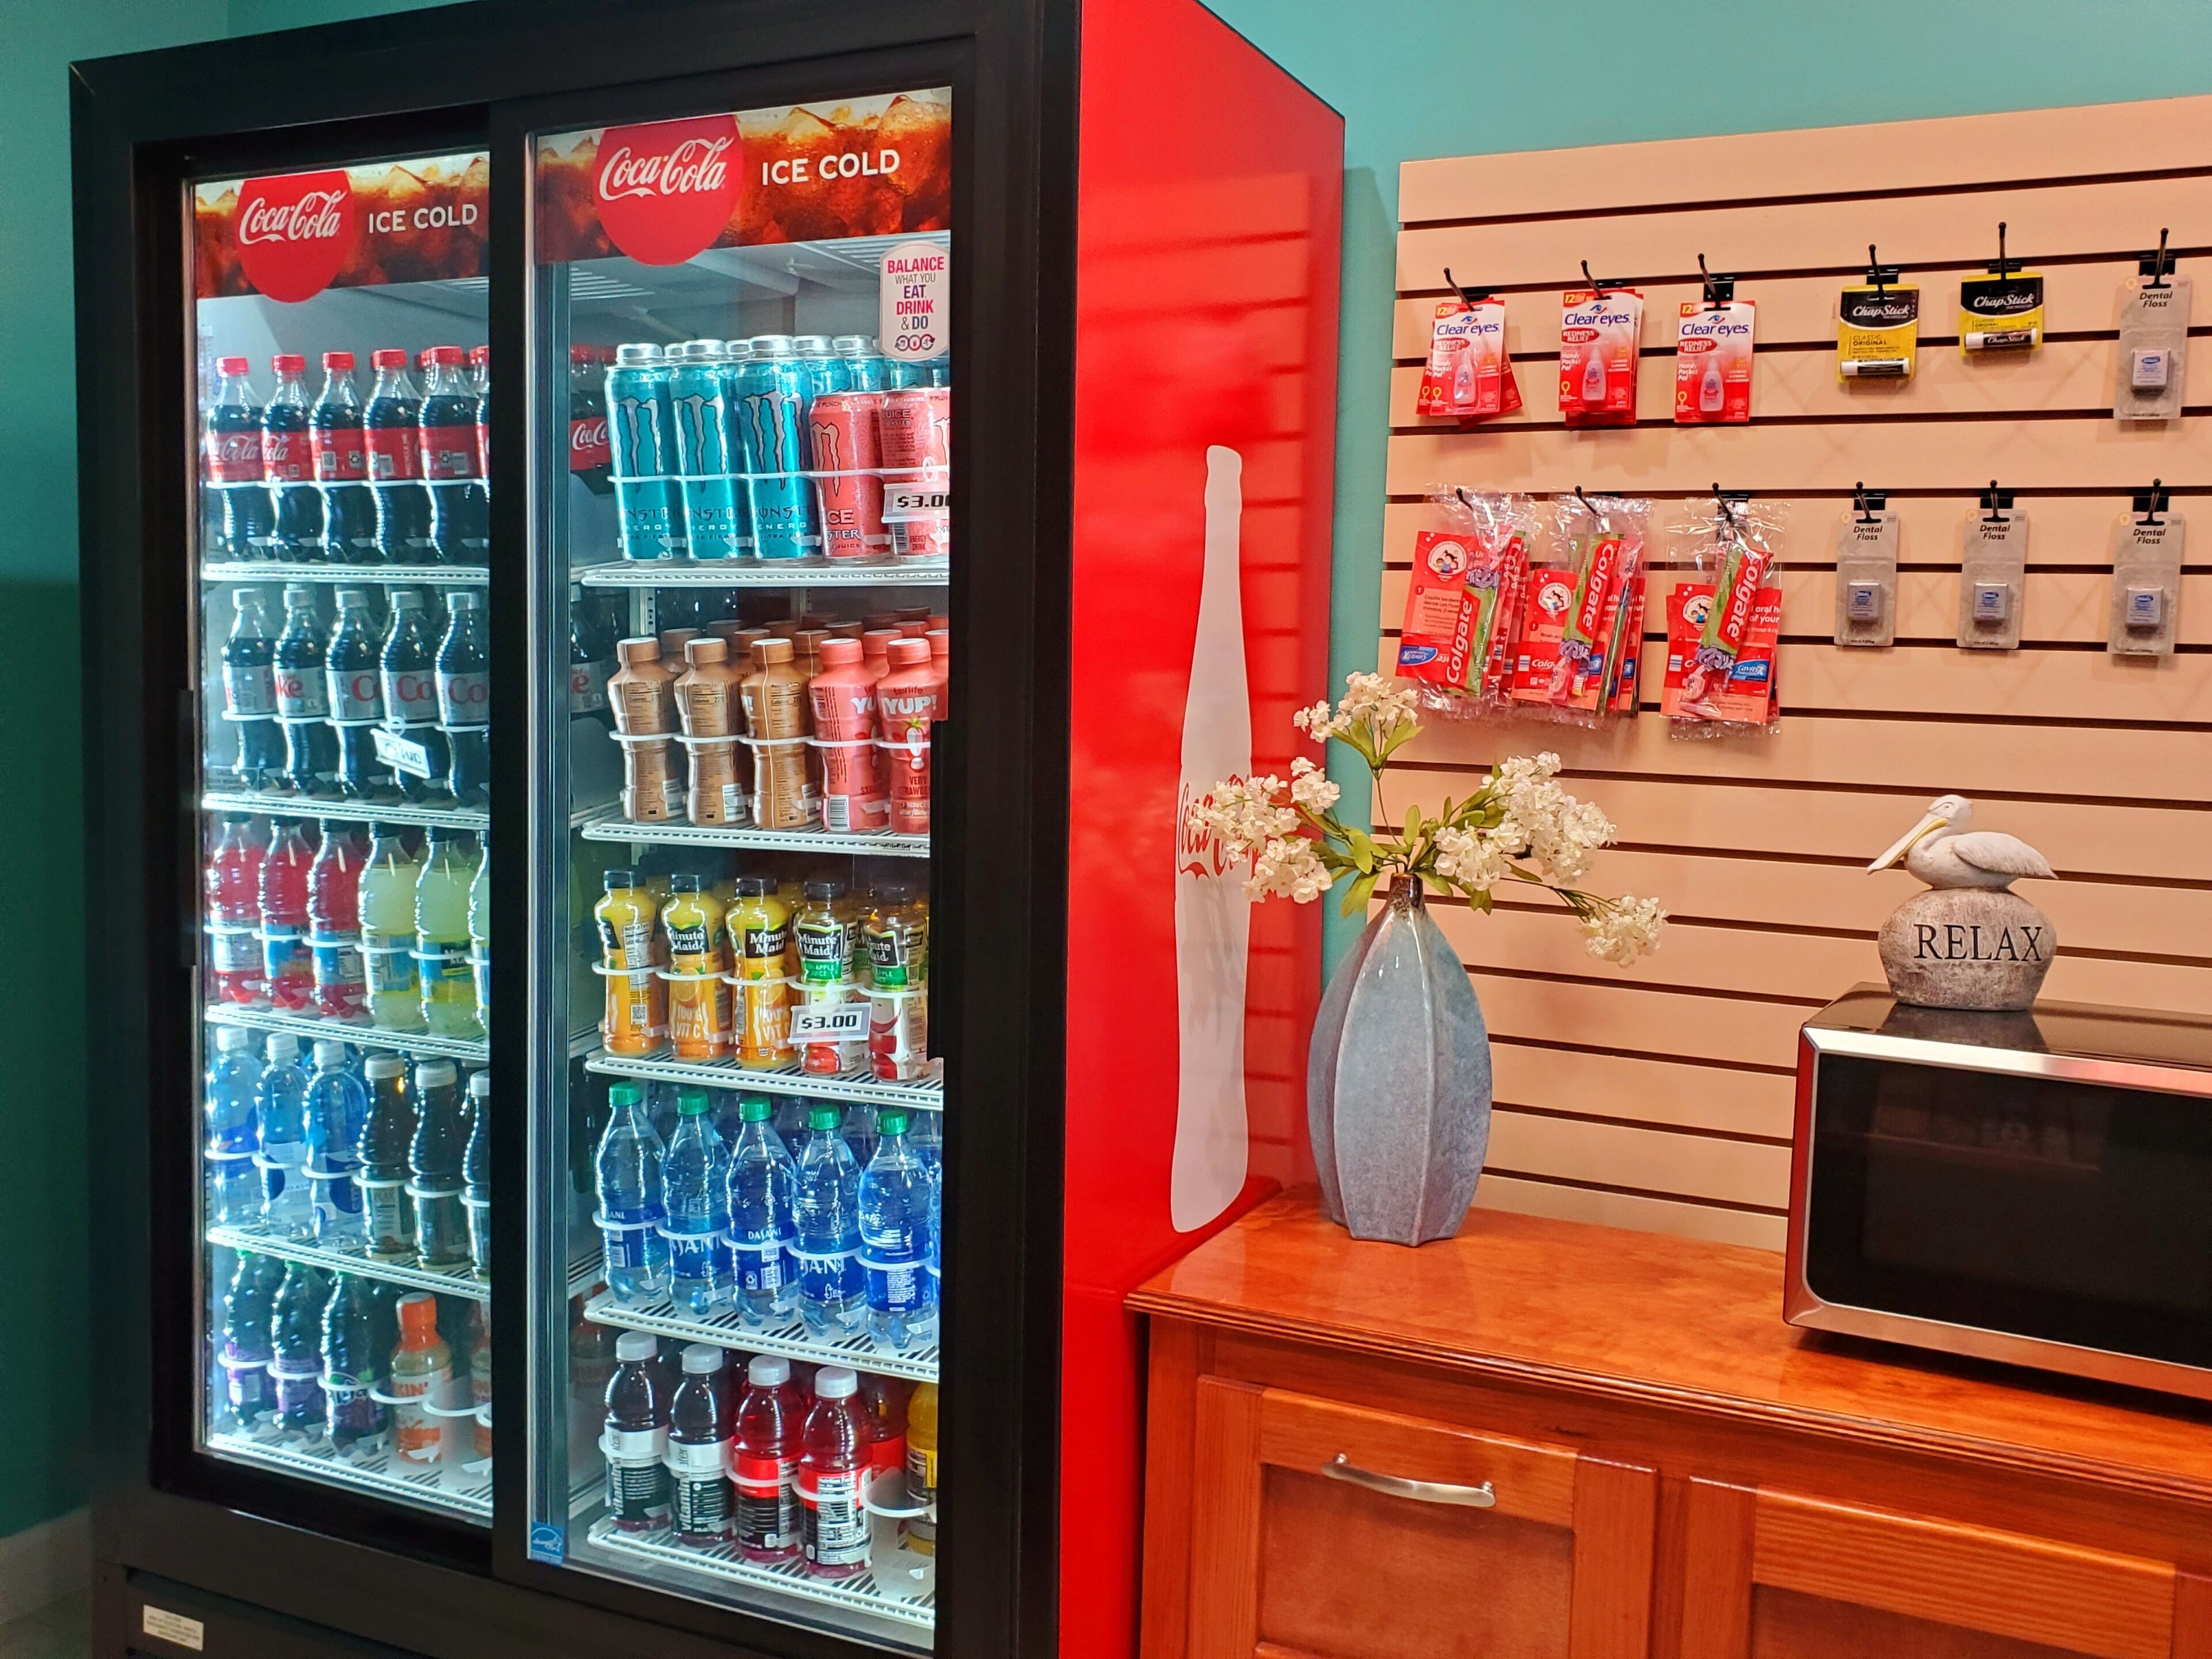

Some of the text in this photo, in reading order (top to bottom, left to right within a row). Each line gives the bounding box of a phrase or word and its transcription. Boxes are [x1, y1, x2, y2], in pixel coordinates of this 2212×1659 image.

[599, 136, 734, 201] Coca-Cola
[762, 150, 900, 185] ICE COLD
[239, 190, 347, 245] Coca-Cola
[368, 204, 478, 233] ICE COLD
[888, 256, 944, 274] BALANCE
[895, 272, 936, 285] WHAT YOU
[1974, 293, 2035, 308] ChapStick
[2139, 291, 2173, 300] Dental
[896, 300, 934, 315] DRINK
[1852, 304, 1910, 318] ChapStick
[2142, 300, 2168, 308] Floss
[901, 316, 929, 330] & DO
[1565, 313, 1630, 327] Clear eyes
[1436, 323, 1499, 336] Clear eyes
[1681, 323, 1749, 337] Clear eyes
[757, 522, 806, 530] ENERG
[1980, 524, 2010, 533] Dental
[2133, 528, 2166, 536] Dental
[2137, 536, 2161, 544] Floss
[1582, 544, 1614, 628] Colgate
[1755, 605, 1772, 613] oral
[1760, 615, 1780, 625] your
[1446, 600, 1473, 684] Colgate
[893, 685, 923, 696] fairlife
[850, 697, 877, 714] YU
[883, 694, 937, 715] YUP!
[801, 933, 837, 945] Minute
[869, 941, 891, 951] nute
[1913, 923, 2042, 961] RELAX
[755, 940, 785, 954] Maid
[804, 944, 831, 956] Maid
[870, 950, 889, 962] aid
[801, 1014, 858, 1029] $3.00
[676, 1023, 700, 1039] VIT C
[748, 1227, 782, 1241] DASANI
